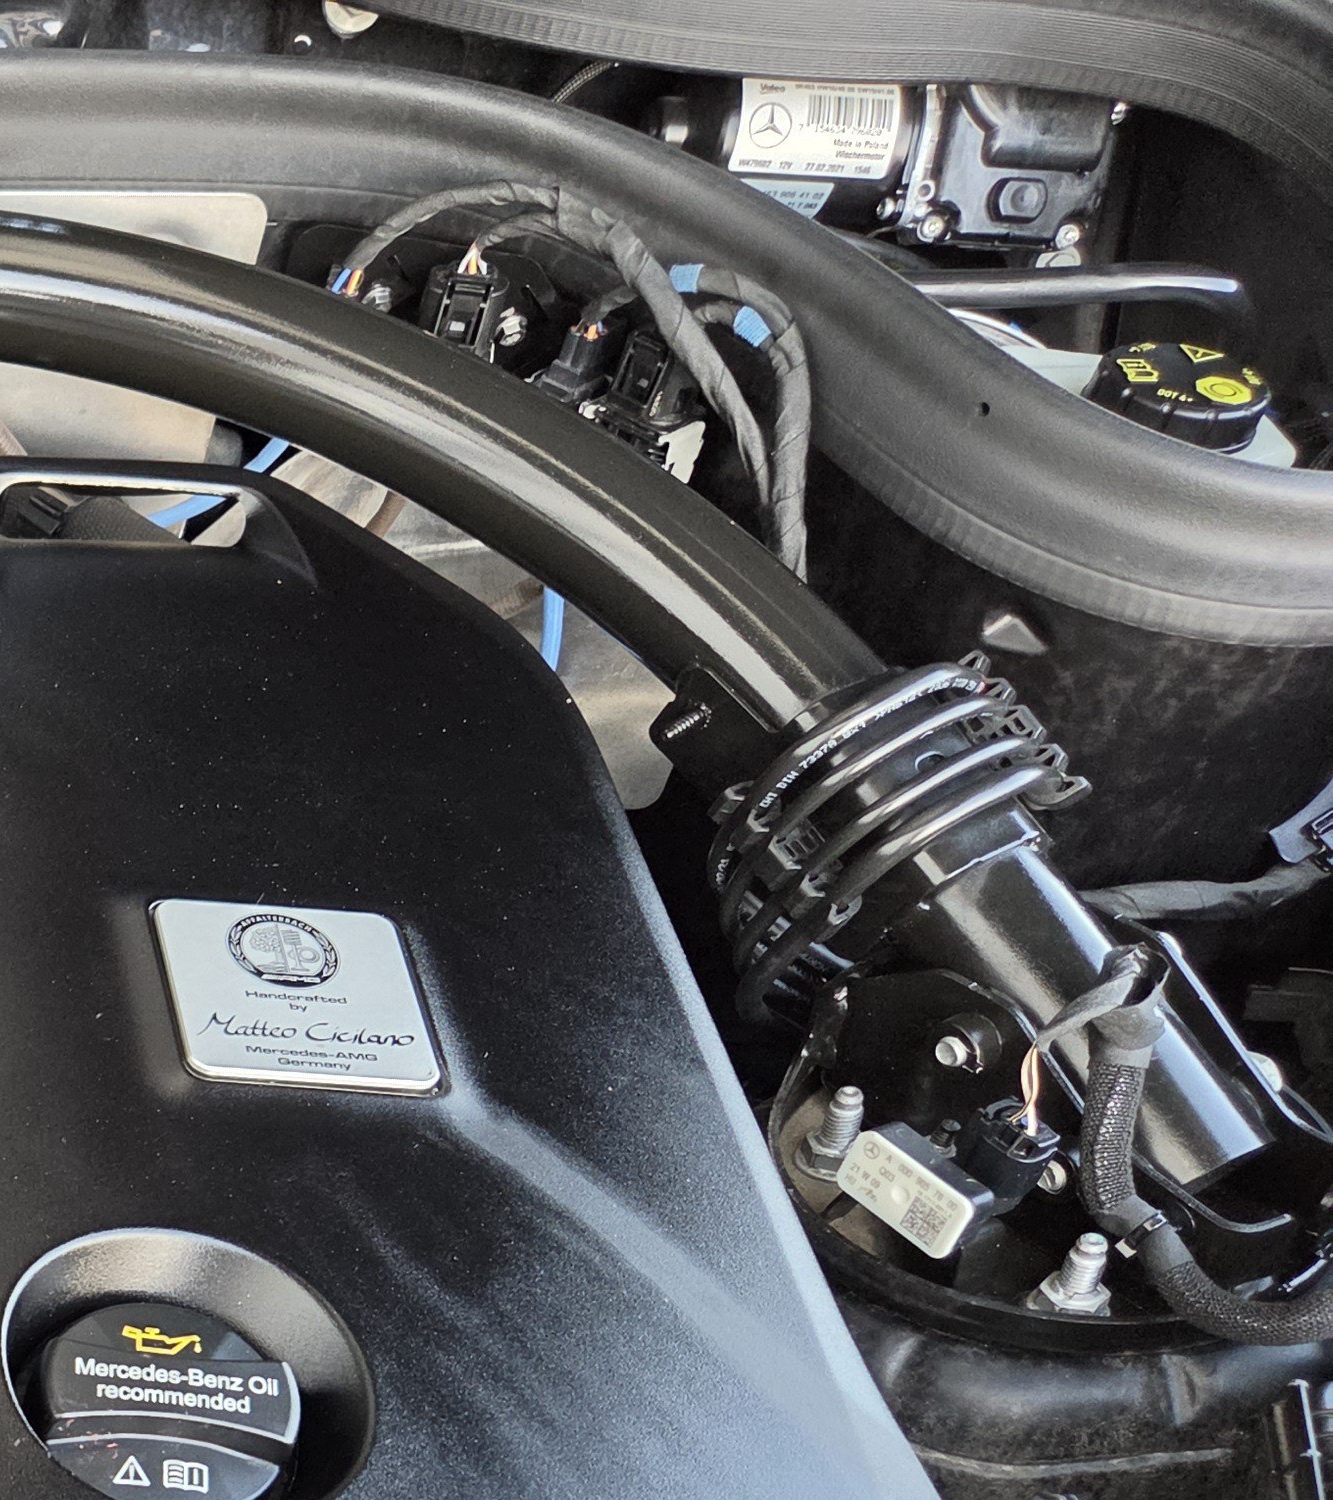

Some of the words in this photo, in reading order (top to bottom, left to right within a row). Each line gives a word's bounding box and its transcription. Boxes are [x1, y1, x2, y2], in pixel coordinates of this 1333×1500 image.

[760, 83, 785, 92] Valeo
[833, 138, 852, 148] Made
[855, 140, 862, 148] in
[864, 140, 889, 150] Poland
[835, 150, 886, 161] Wischermotor
[775, 769, 800, 790] DIN
[244, 989, 348, 1005] Handcrafted
[289, 1002, 308, 1013] by
[197, 1011, 298, 1039] Matteo
[245, 1044, 378, 1062] Mercedes-AMG
[277, 1056, 352, 1071] Germany
[885, 1154, 894, 1165] A
[74, 1356, 245, 1392] Mercedes-Benz
[247, 1374, 280, 1397] Oil
[95, 1382, 252, 1415] recommended
